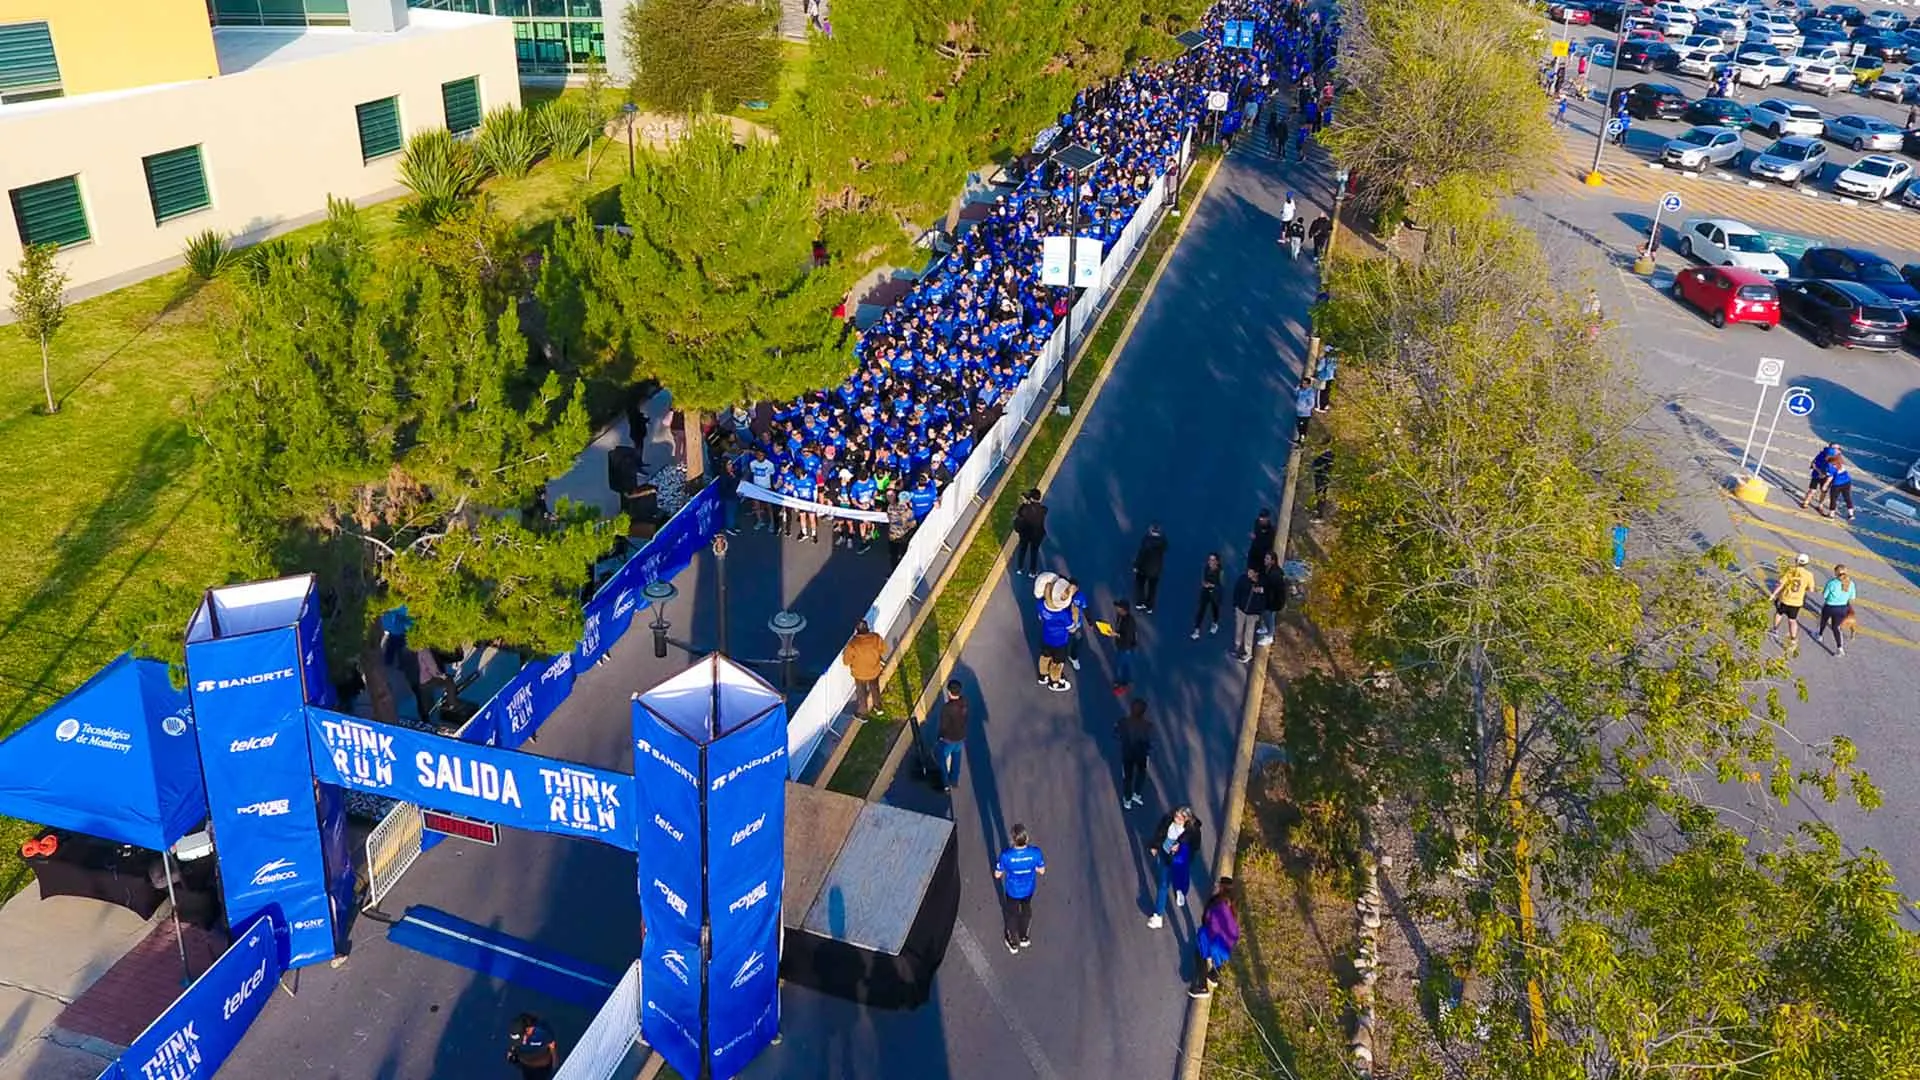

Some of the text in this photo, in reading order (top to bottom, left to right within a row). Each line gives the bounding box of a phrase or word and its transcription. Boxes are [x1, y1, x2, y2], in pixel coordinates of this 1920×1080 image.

[218, 667, 294, 690] BANORTE
[506, 682, 533, 719] THINK
[76, 734, 132, 754] de Monterrey
[81, 722, 131, 741] Tecnológico
[229, 731, 279, 753] telcel
[321, 720, 397, 761] THINK
[332, 748, 394, 787] RUN
[415, 751, 522, 808] SALIDA
[727, 746, 785, 782] BANORTE
[539, 768, 620, 808] THINK
[550, 796, 616, 830] RUN
[730, 812, 767, 847] telcel
[223, 958, 267, 1020] telcel
[140, 1019, 200, 1080] THINK
[156, 1044, 202, 1080] UN
